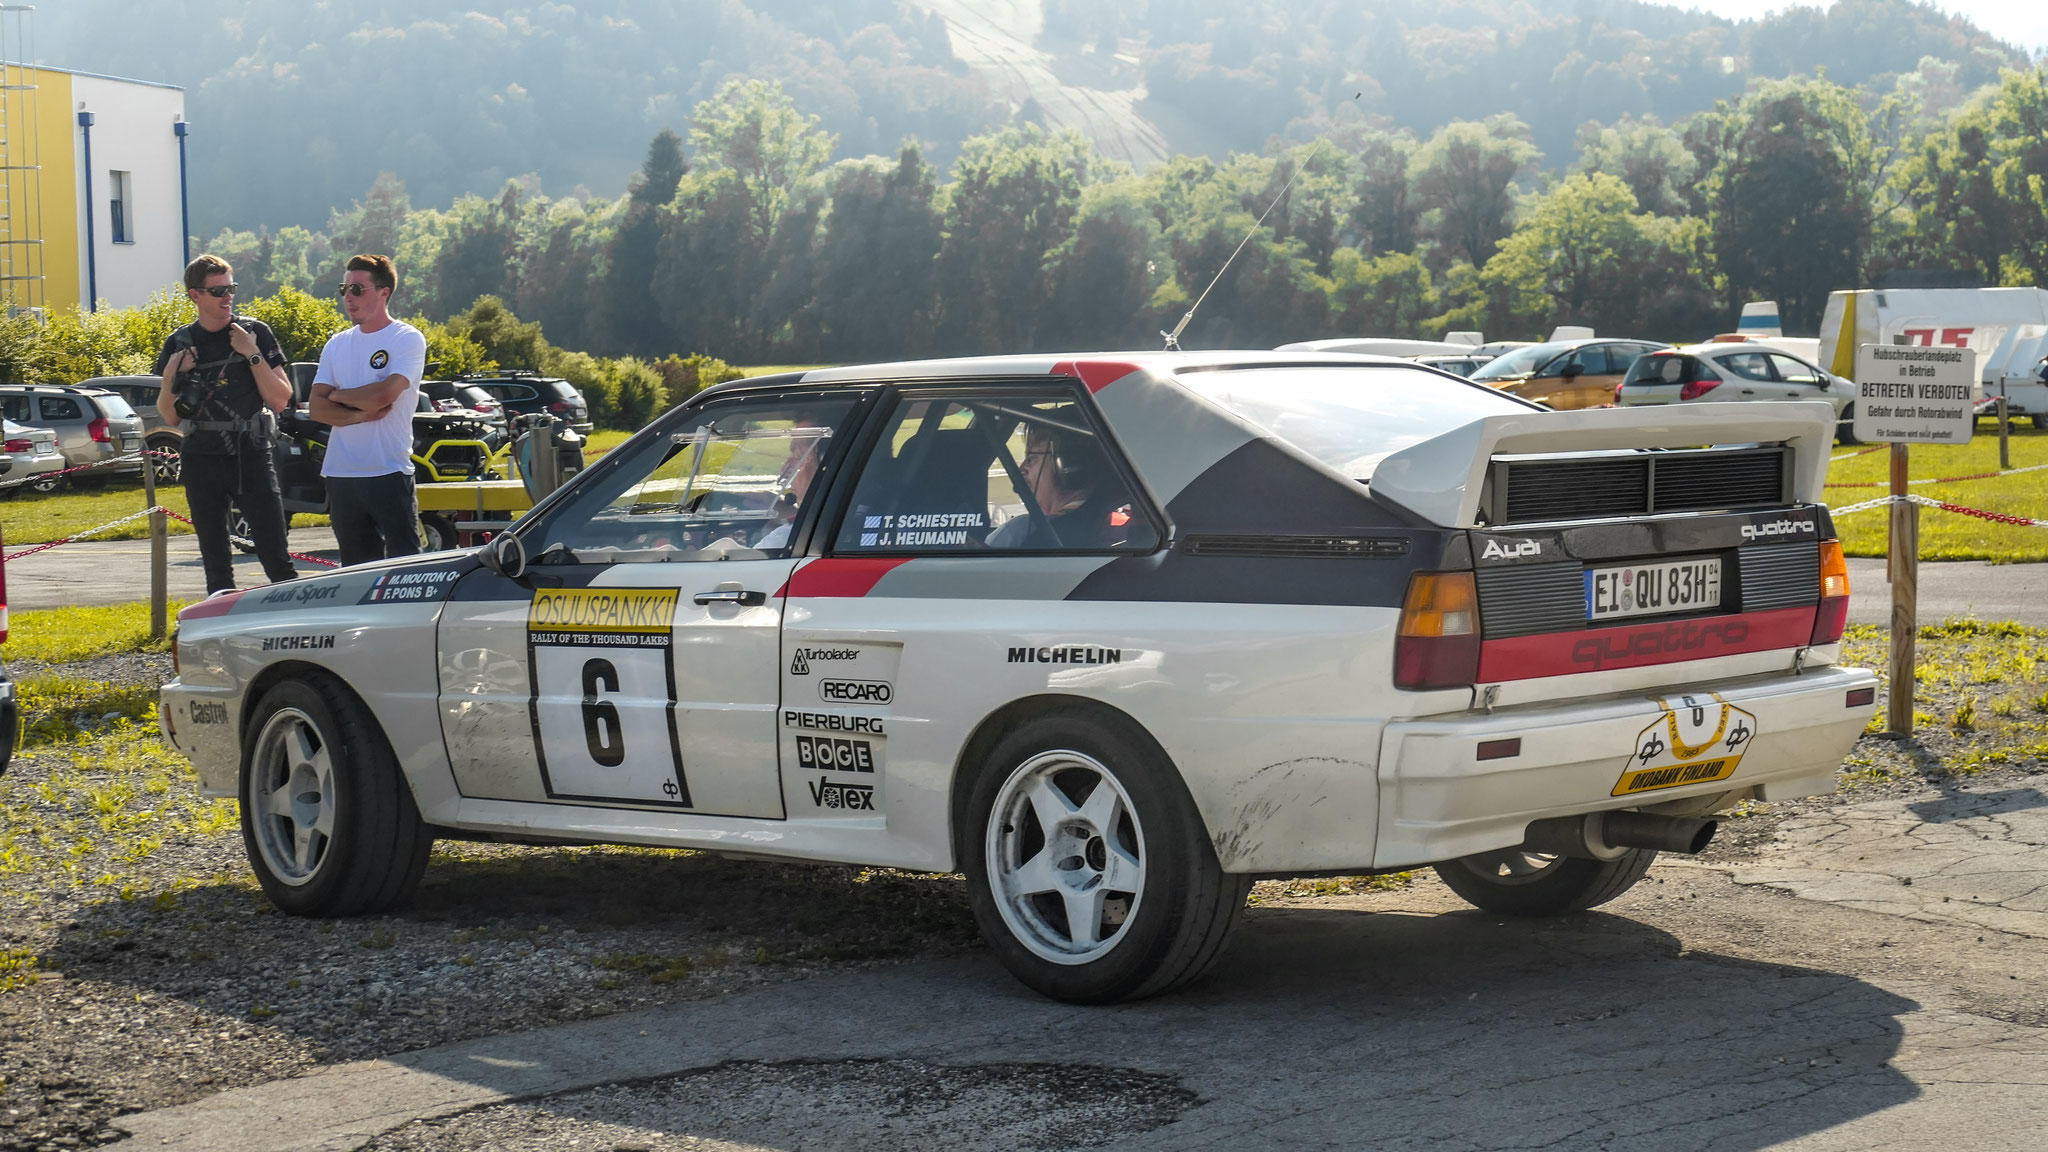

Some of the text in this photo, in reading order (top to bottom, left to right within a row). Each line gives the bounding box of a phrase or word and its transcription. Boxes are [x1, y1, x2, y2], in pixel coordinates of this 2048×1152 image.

[1873, 348, 1962, 363] Hubschrauberlandeplatz
[1899, 364, 1935, 377] in Betrieb
[1862, 382, 1970, 400] BETRETEN VERBOTEN
[1868, 405, 1962, 419] Gefahr durch Rotorabwind
[884, 514, 983, 528] T. SCHIESTERL
[1741, 520, 1814, 540] quattro
[880, 531, 968, 546] J. HEUMANN
[1481, 539, 1541, 559] Audi
[1709, 563, 1718, 575] 04
[260, 584, 342, 605] Audi Sport
[1595, 565, 1707, 613] EI QU 83H
[1709, 590, 1717, 601] 11
[535, 594, 673, 628] OSUUSPANKKI
[263, 635, 335, 651] MICHELIN
[531, 633, 669, 646] RALLY OF THE THOUSAND LAKES
[1571, 620, 1749, 671] quattro
[804, 648, 860, 660] Turbolader
[1007, 647, 1121, 664] MICHELIN
[824, 682, 890, 701] RECARO
[190, 699, 229, 724] Castrol
[581, 657, 625, 768] 6
[785, 711, 883, 733] PIERBURG
[799, 741, 870, 767] BOGE
[1628, 760, 1725, 791] OKOBANK FINLAND
